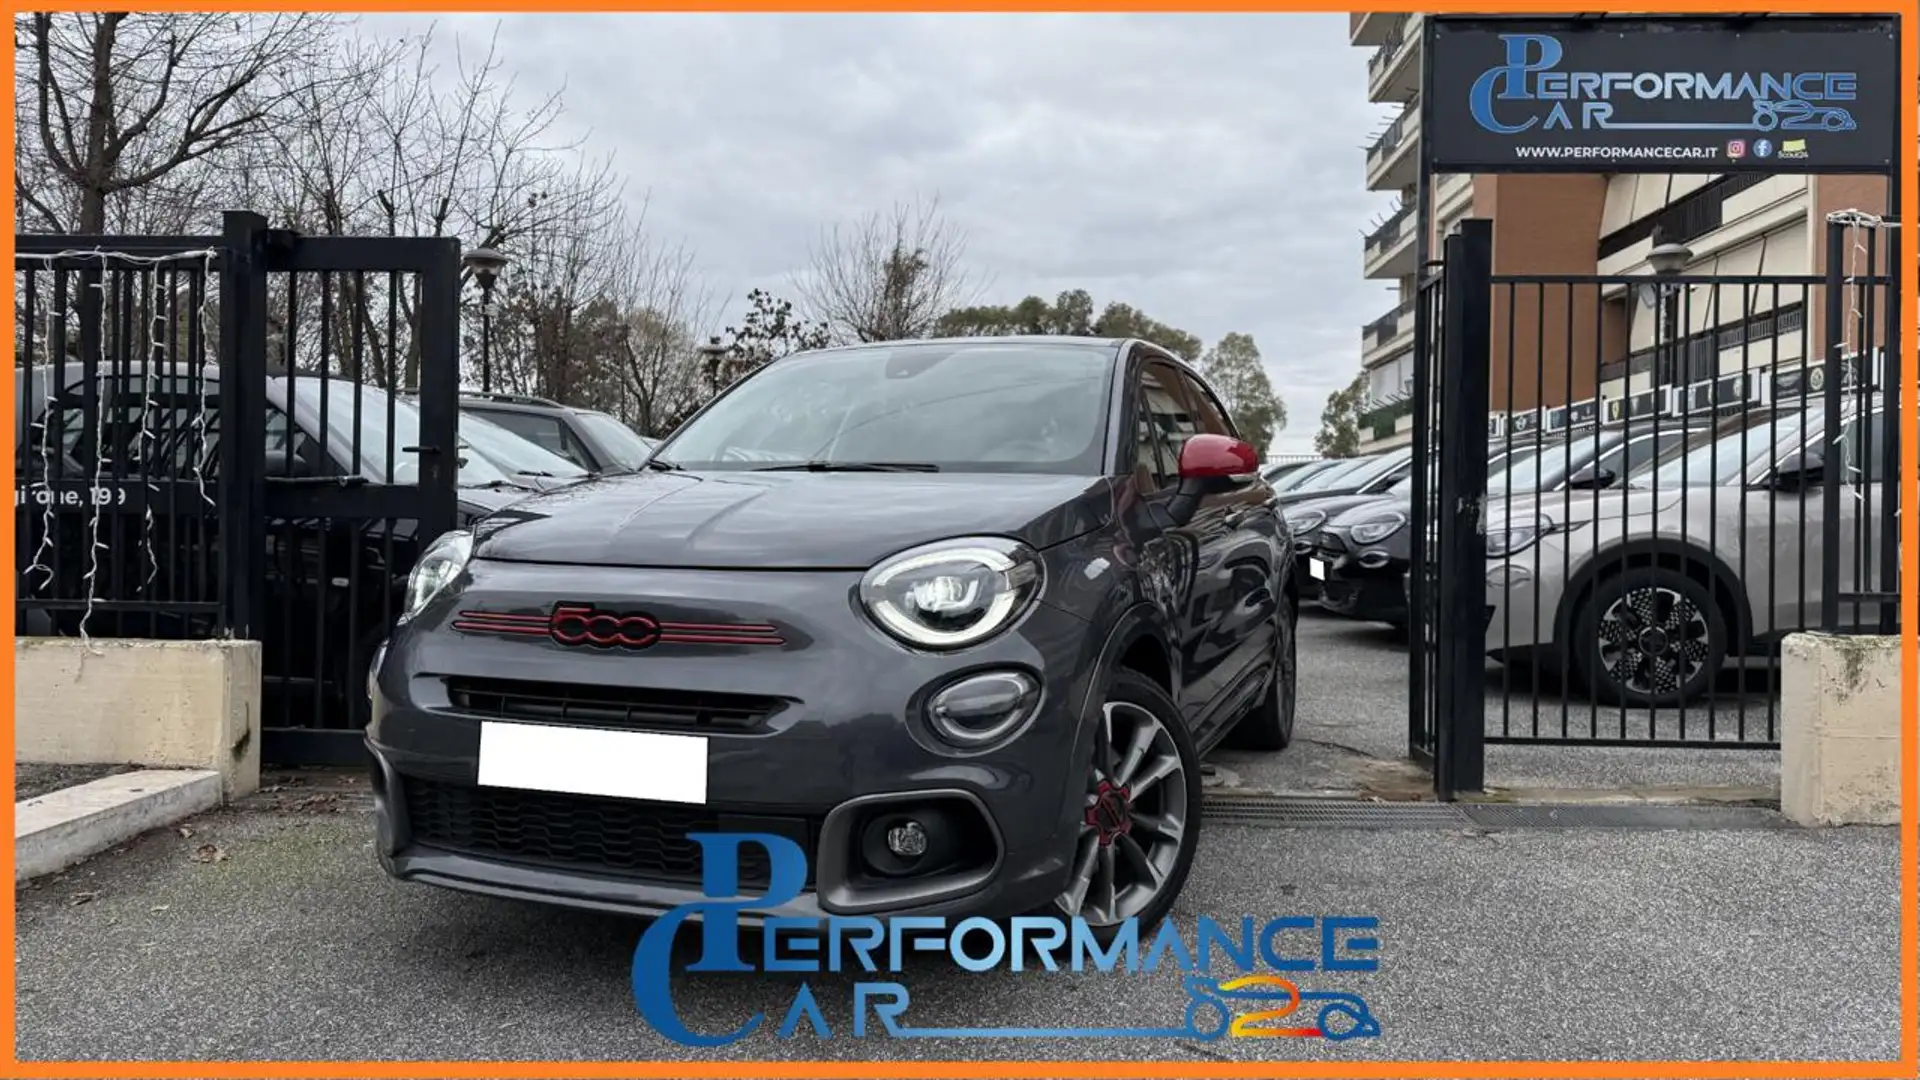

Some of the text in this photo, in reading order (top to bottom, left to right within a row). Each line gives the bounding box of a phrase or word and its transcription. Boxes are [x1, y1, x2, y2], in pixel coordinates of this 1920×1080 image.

[1497, 34, 1857, 100] PERFORMANCE
[1469, 64, 1614, 134] CAR
[1515, 146, 1718, 159] WWW.PERFORMANCECAR.IT
[552, 605, 660, 646] 500
